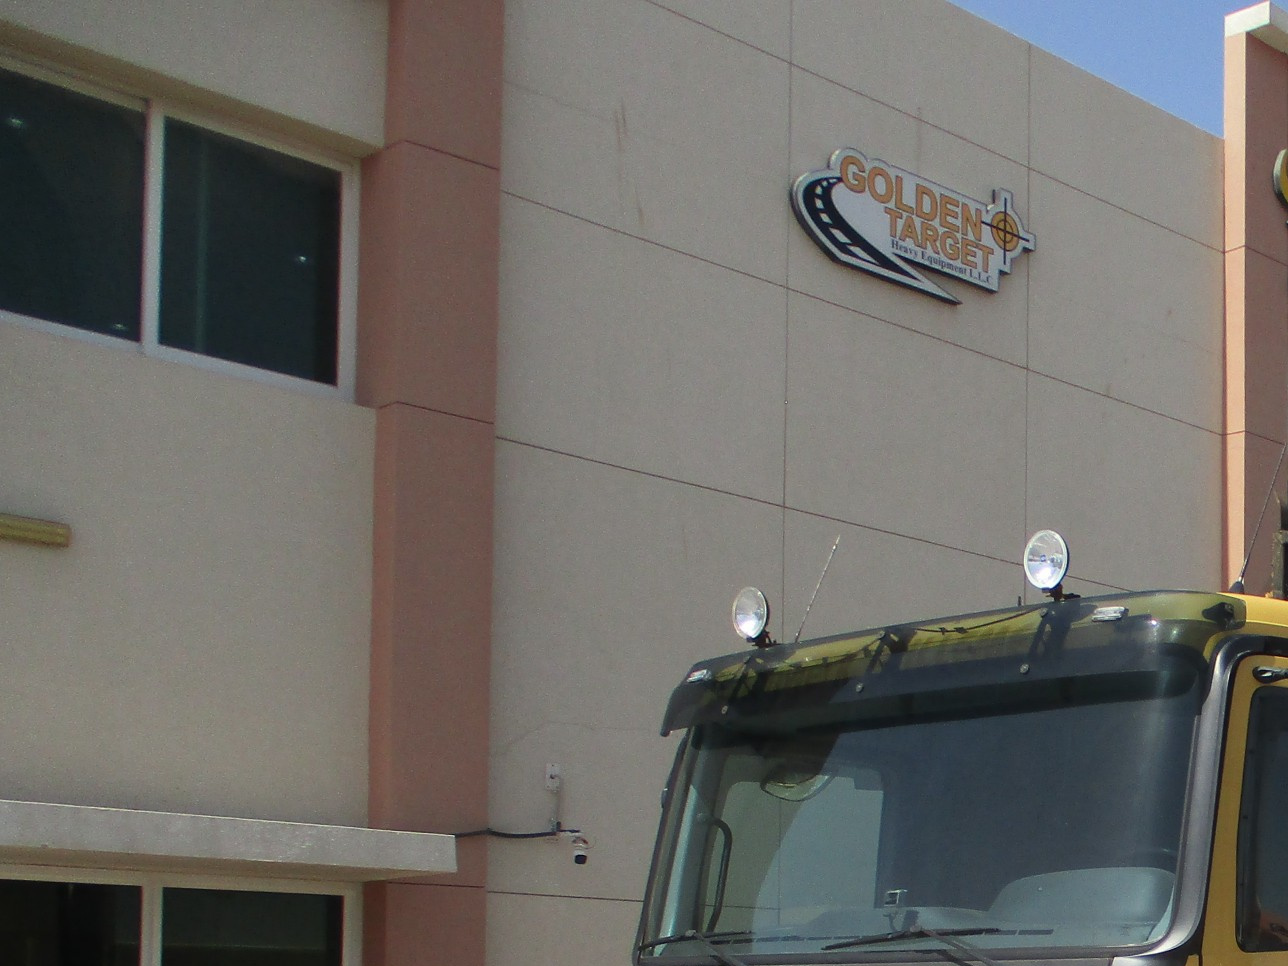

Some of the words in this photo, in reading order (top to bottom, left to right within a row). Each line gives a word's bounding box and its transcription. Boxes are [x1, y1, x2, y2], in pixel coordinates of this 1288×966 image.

[839, 155, 983, 243] GOLDEN
[884, 206, 995, 273] TARGET
[890, 238, 918, 257] Heavy
[921, 251, 967, 276] Equipment
